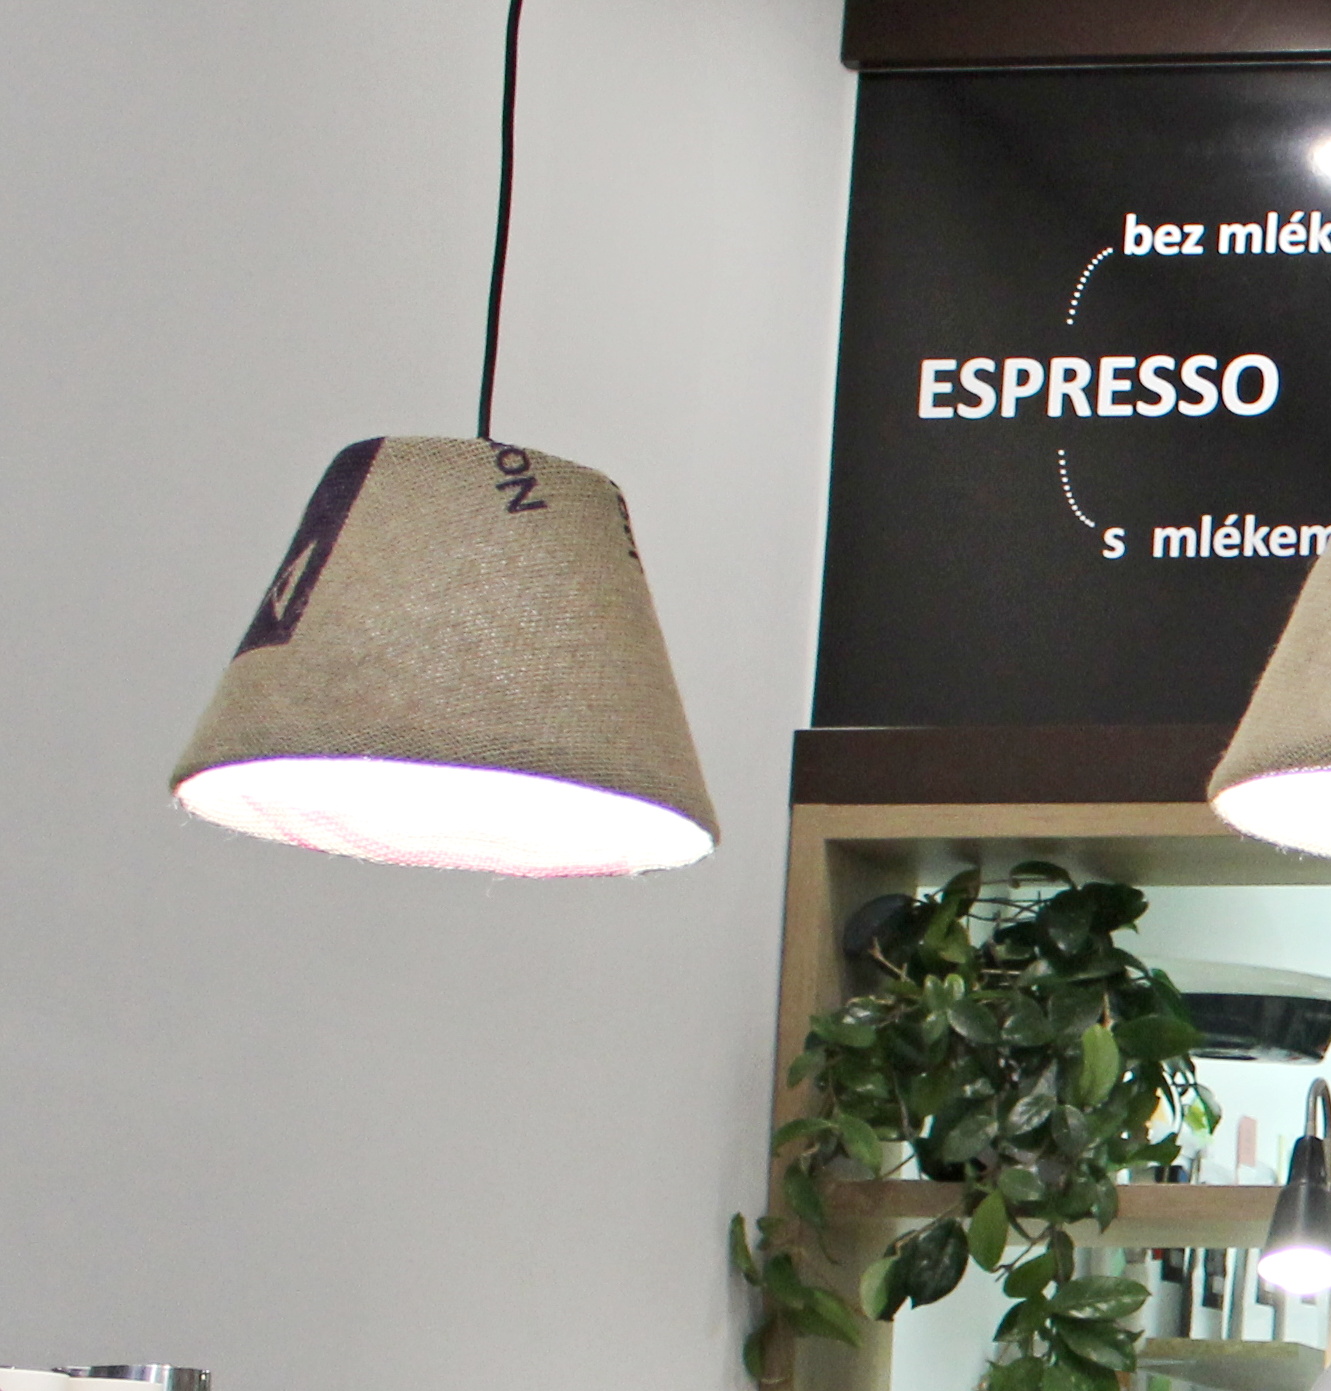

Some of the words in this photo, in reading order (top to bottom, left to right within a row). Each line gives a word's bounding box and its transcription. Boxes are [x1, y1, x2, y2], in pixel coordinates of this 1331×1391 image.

[1124, 213, 1204, 255] bez
[918, 354, 1280, 419] ESPRESSO
[1102, 527, 1127, 560] s
